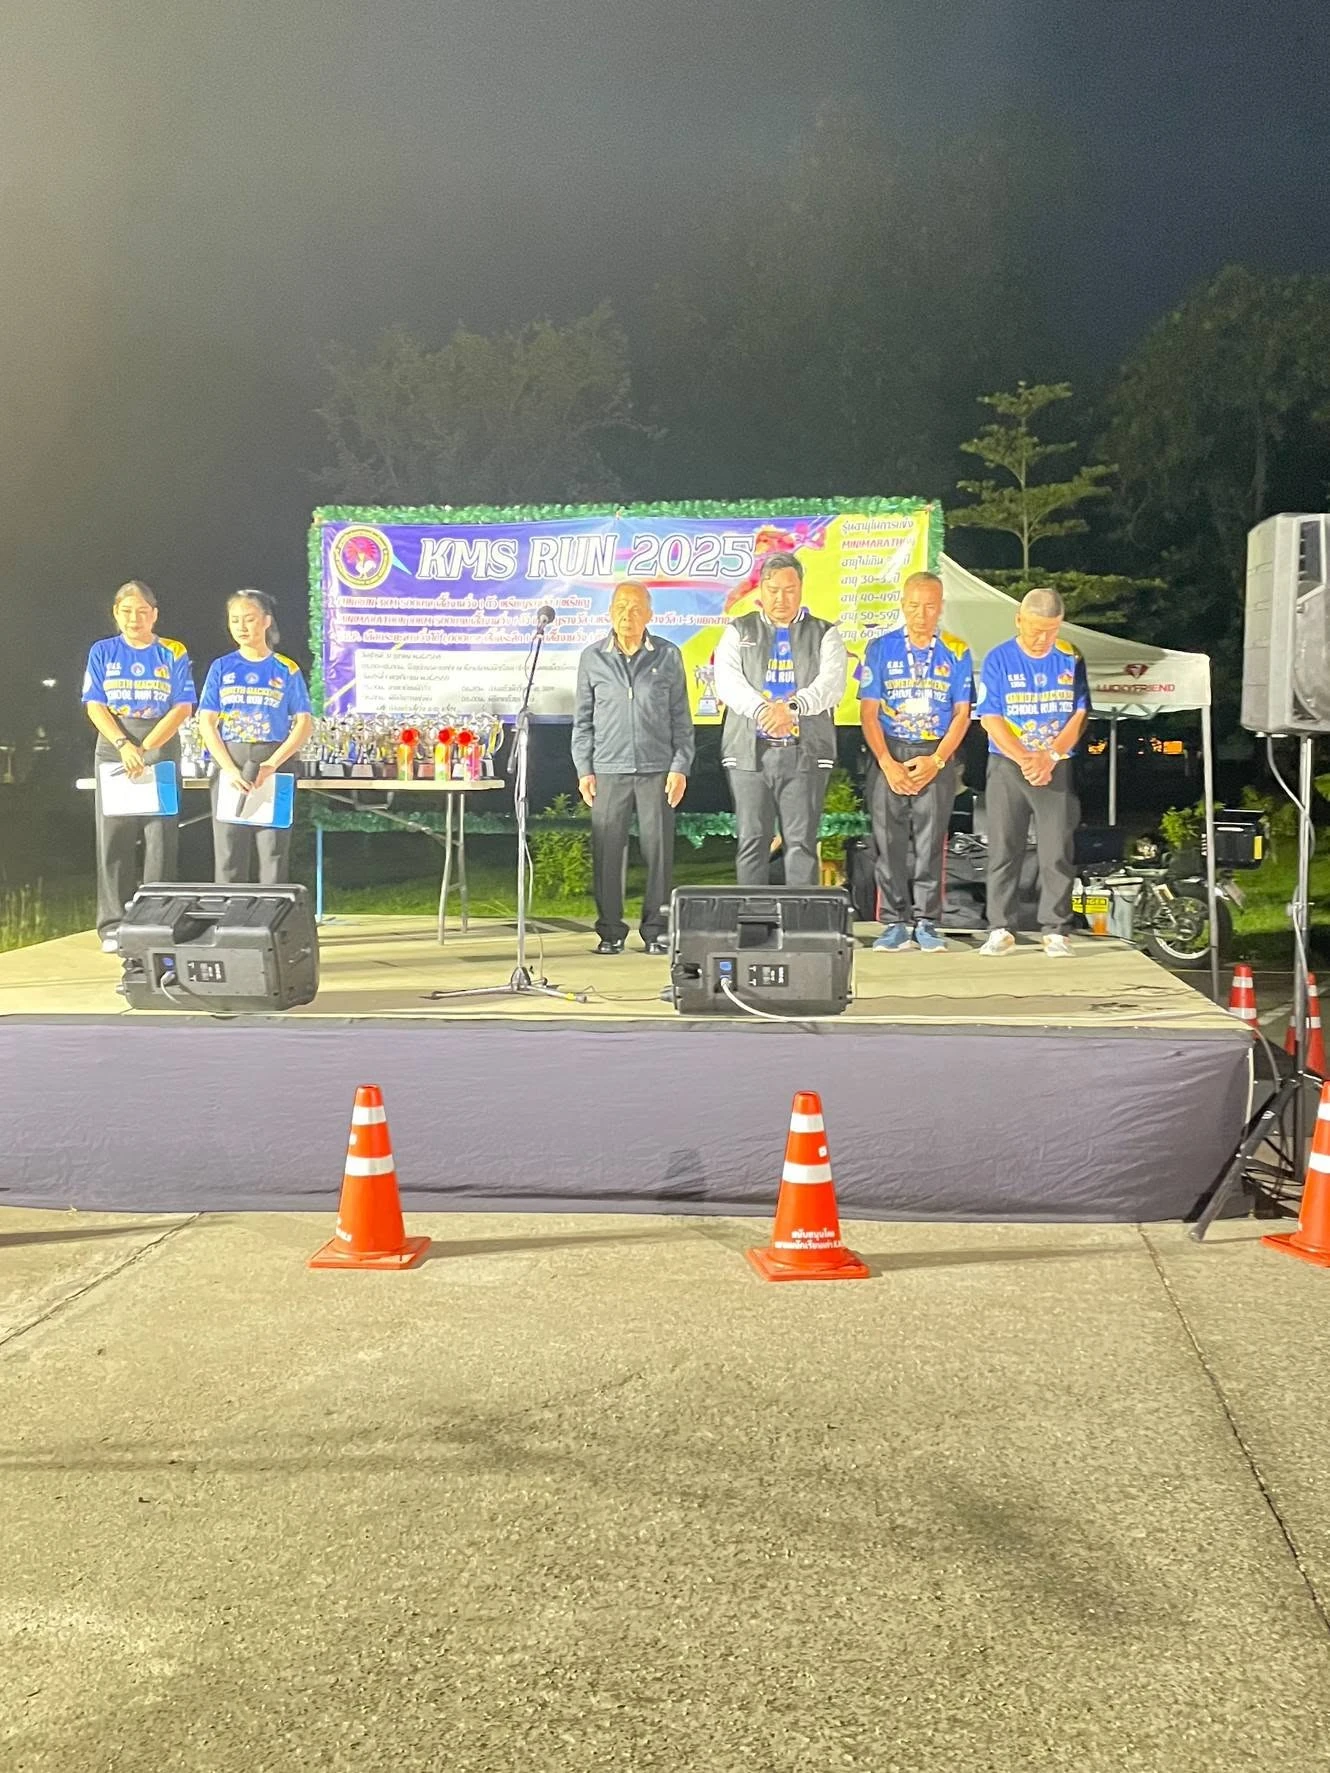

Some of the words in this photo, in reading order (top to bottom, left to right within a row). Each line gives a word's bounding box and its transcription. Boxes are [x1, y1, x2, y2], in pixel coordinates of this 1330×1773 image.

[417, 538, 518, 580] KMS
[526, 535, 618, 579] RUN
[627, 534, 756, 578] 2025
